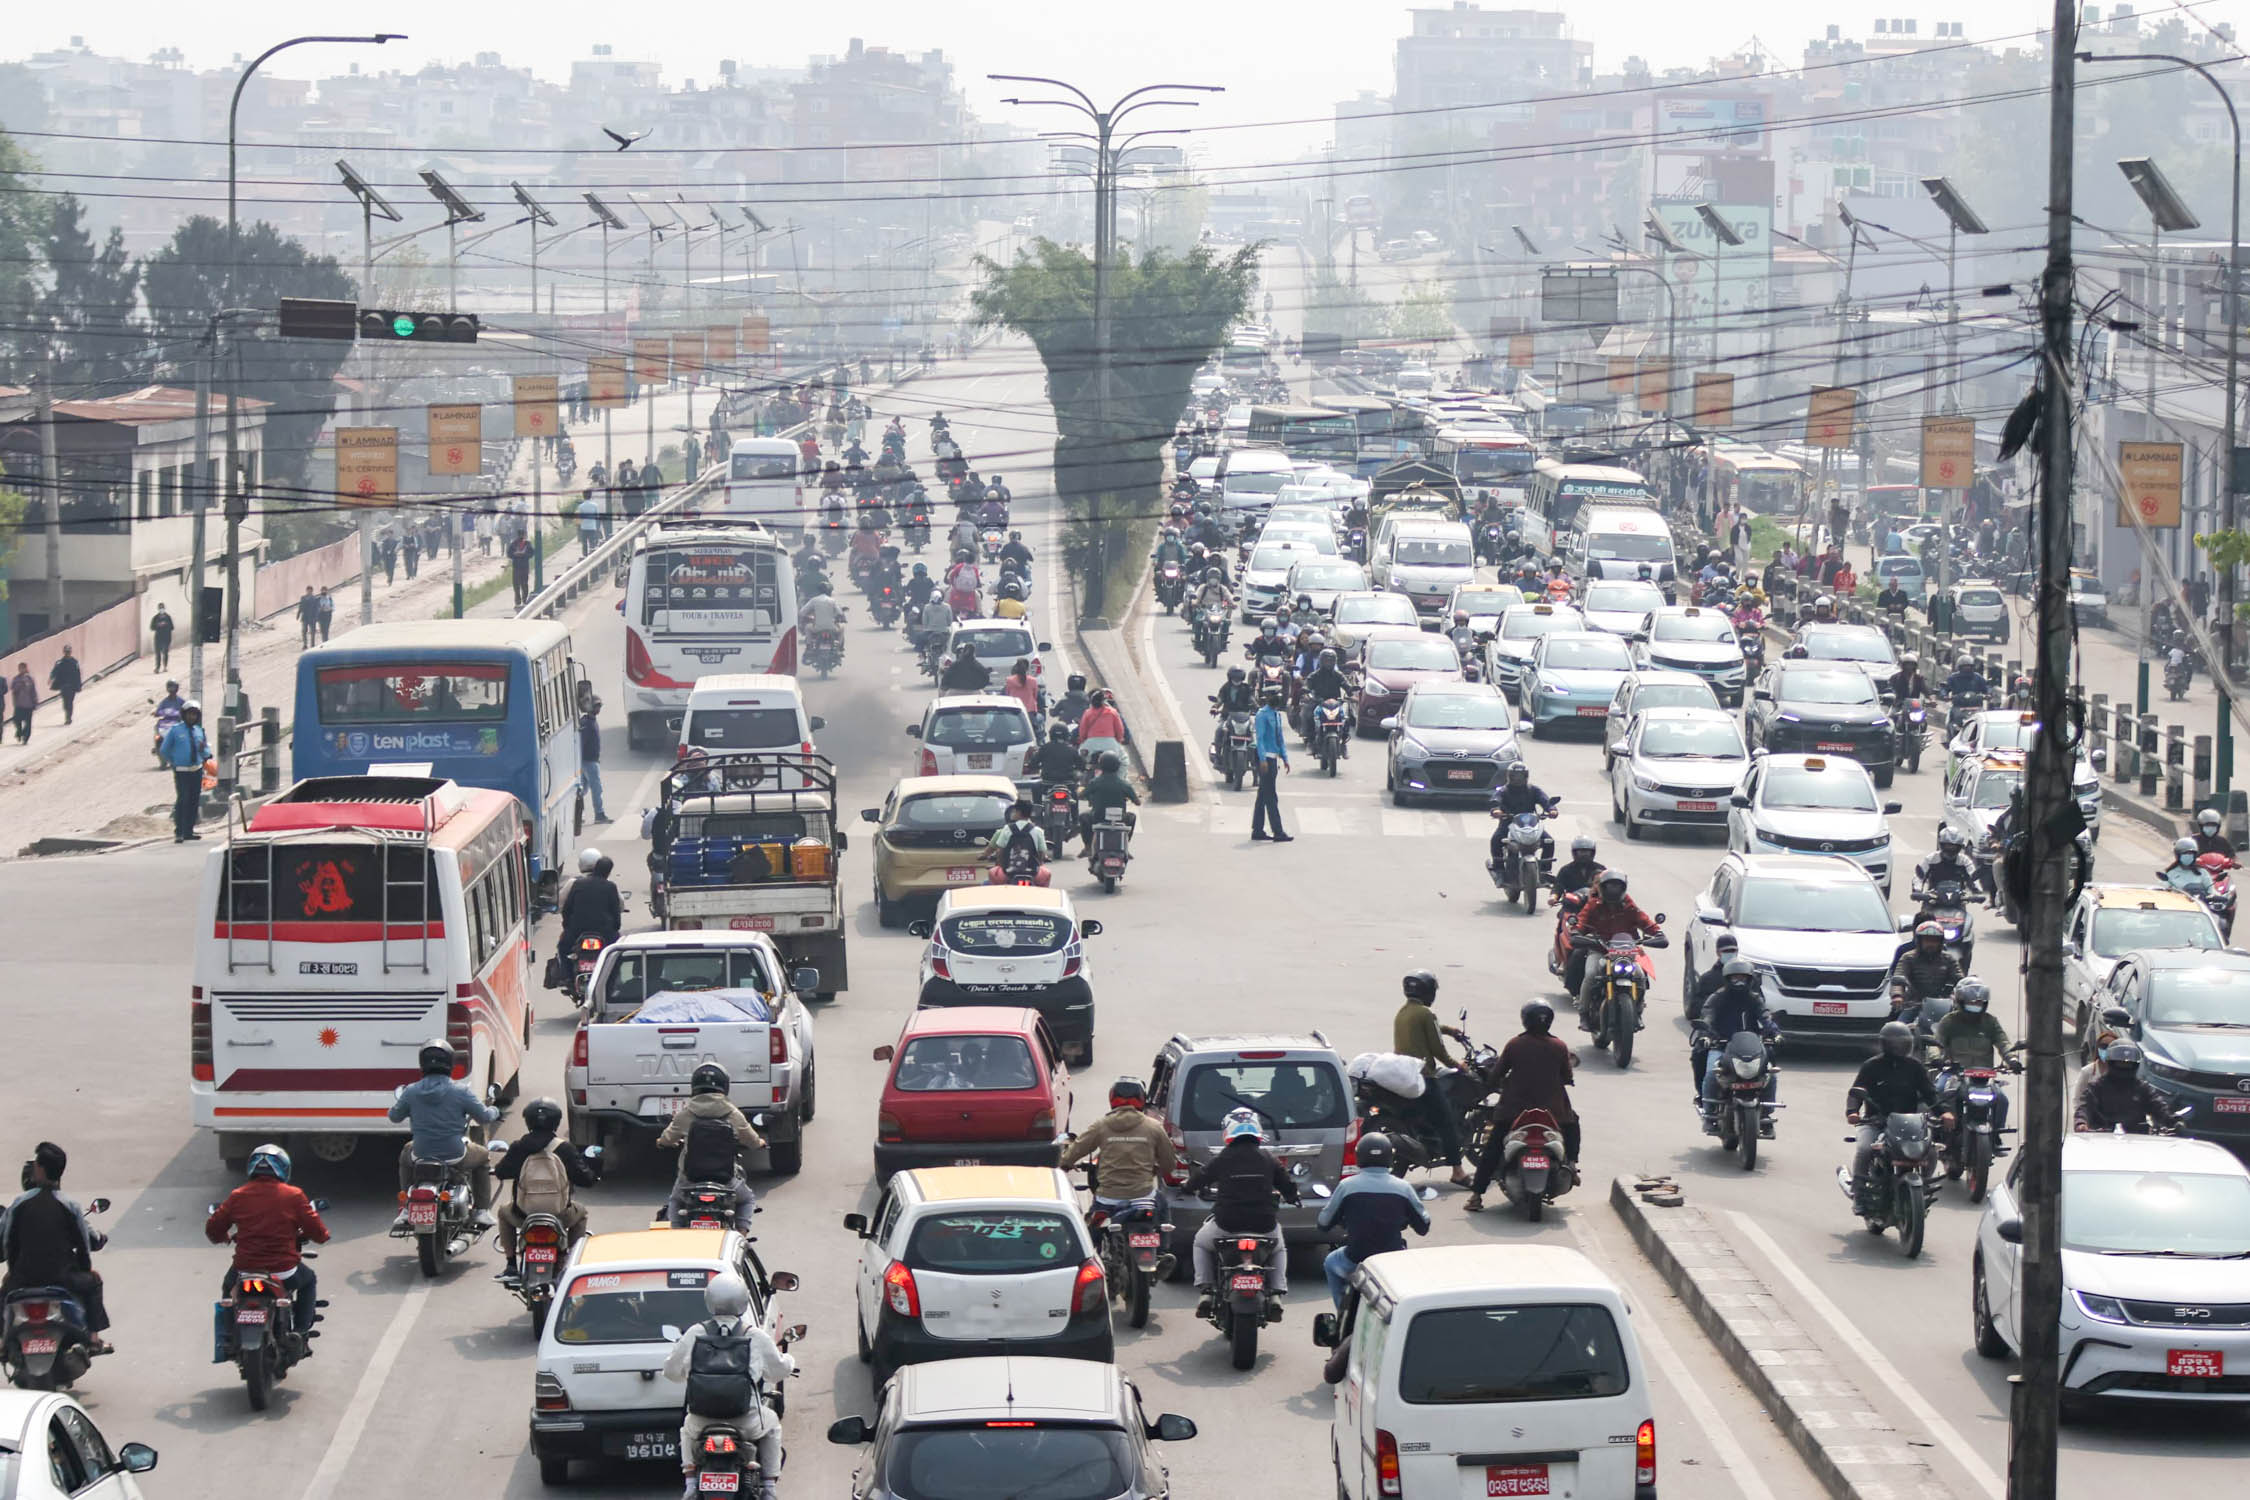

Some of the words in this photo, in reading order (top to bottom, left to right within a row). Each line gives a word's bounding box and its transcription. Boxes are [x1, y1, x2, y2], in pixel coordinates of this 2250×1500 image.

[1671, 221, 1758, 239] zura
[682, 612, 702, 620] TOUR
[710, 612, 744, 620] TRAVELS
[968, 984, 995, 992] Don't
[587, 1276, 620, 1288] YANGO
[2174, 1308, 2211, 1317] BYD
